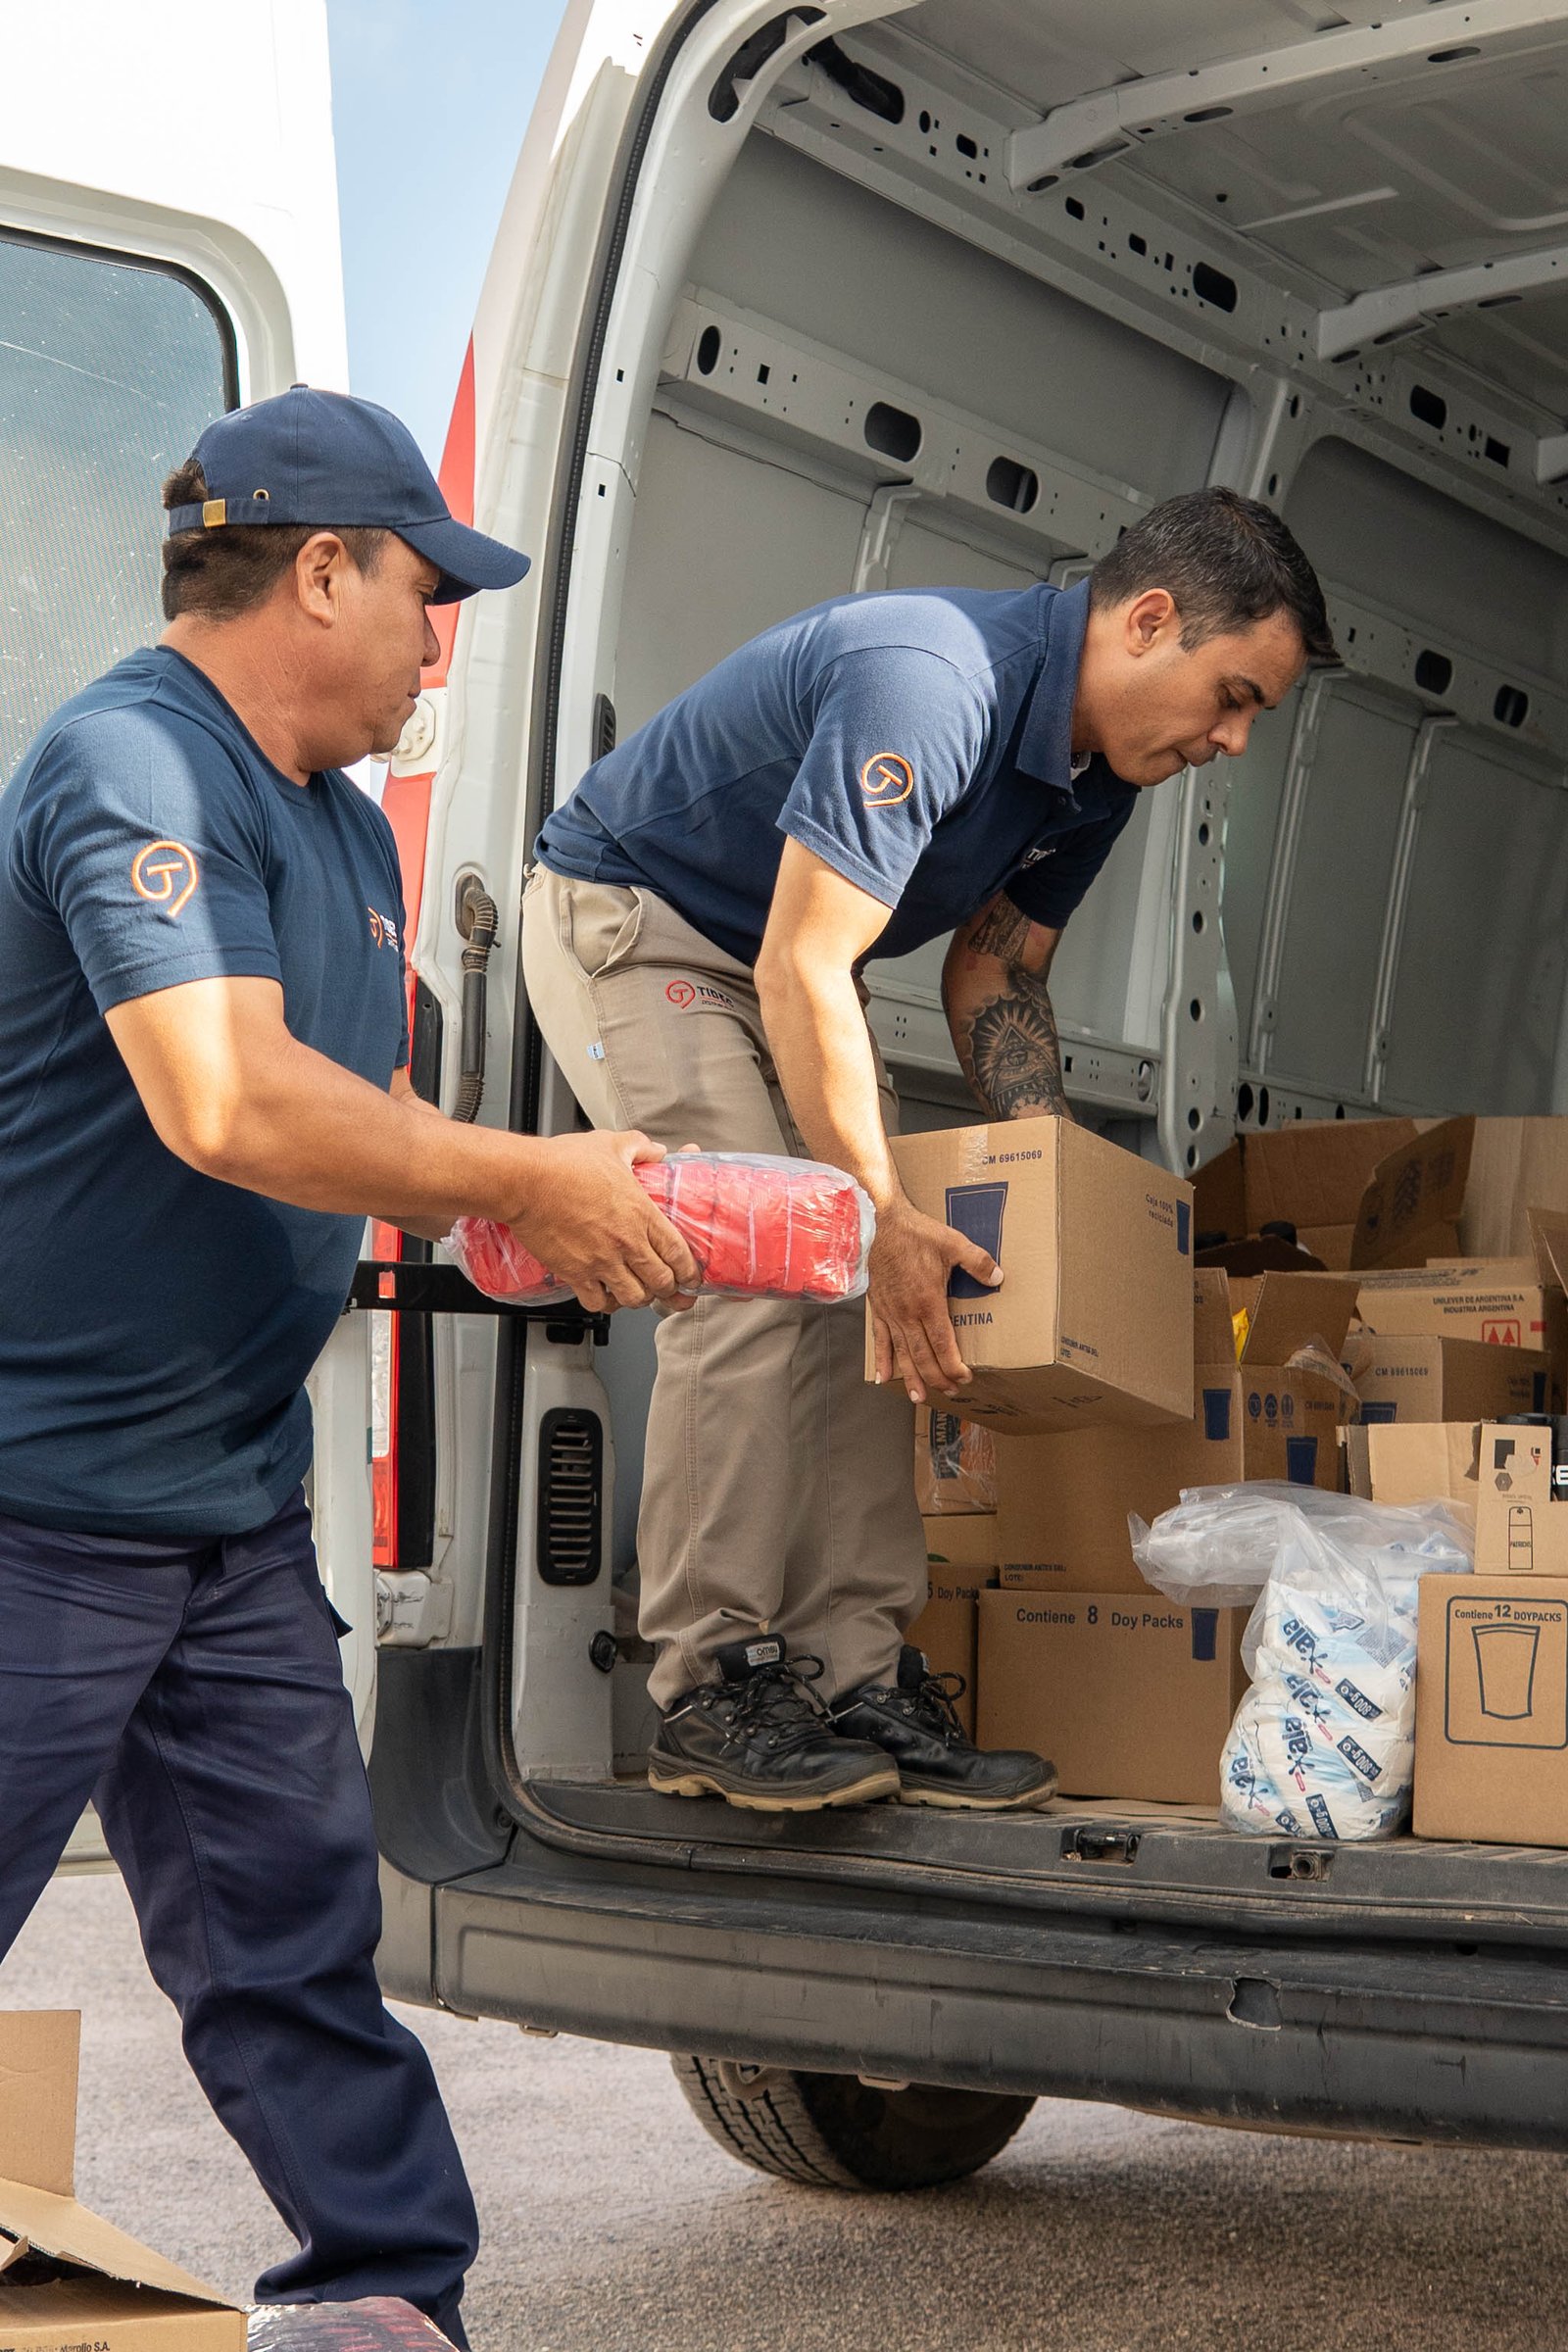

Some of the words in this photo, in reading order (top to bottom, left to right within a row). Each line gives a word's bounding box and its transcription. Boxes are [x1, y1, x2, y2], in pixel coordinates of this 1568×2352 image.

[999, 1150, 1043, 1163] 69615069
[1016, 1608, 1076, 1624] Contiene
[1087, 1604, 1099, 1625] 8
[1111, 1612, 1139, 1630] Doy
[1142, 1614, 1184, 1629] Packs
[1454, 1609, 1494, 1620] Contiene
[1494, 1604, 1511, 1618] 12
[1513, 1611, 1562, 1622] DOYPACKS
